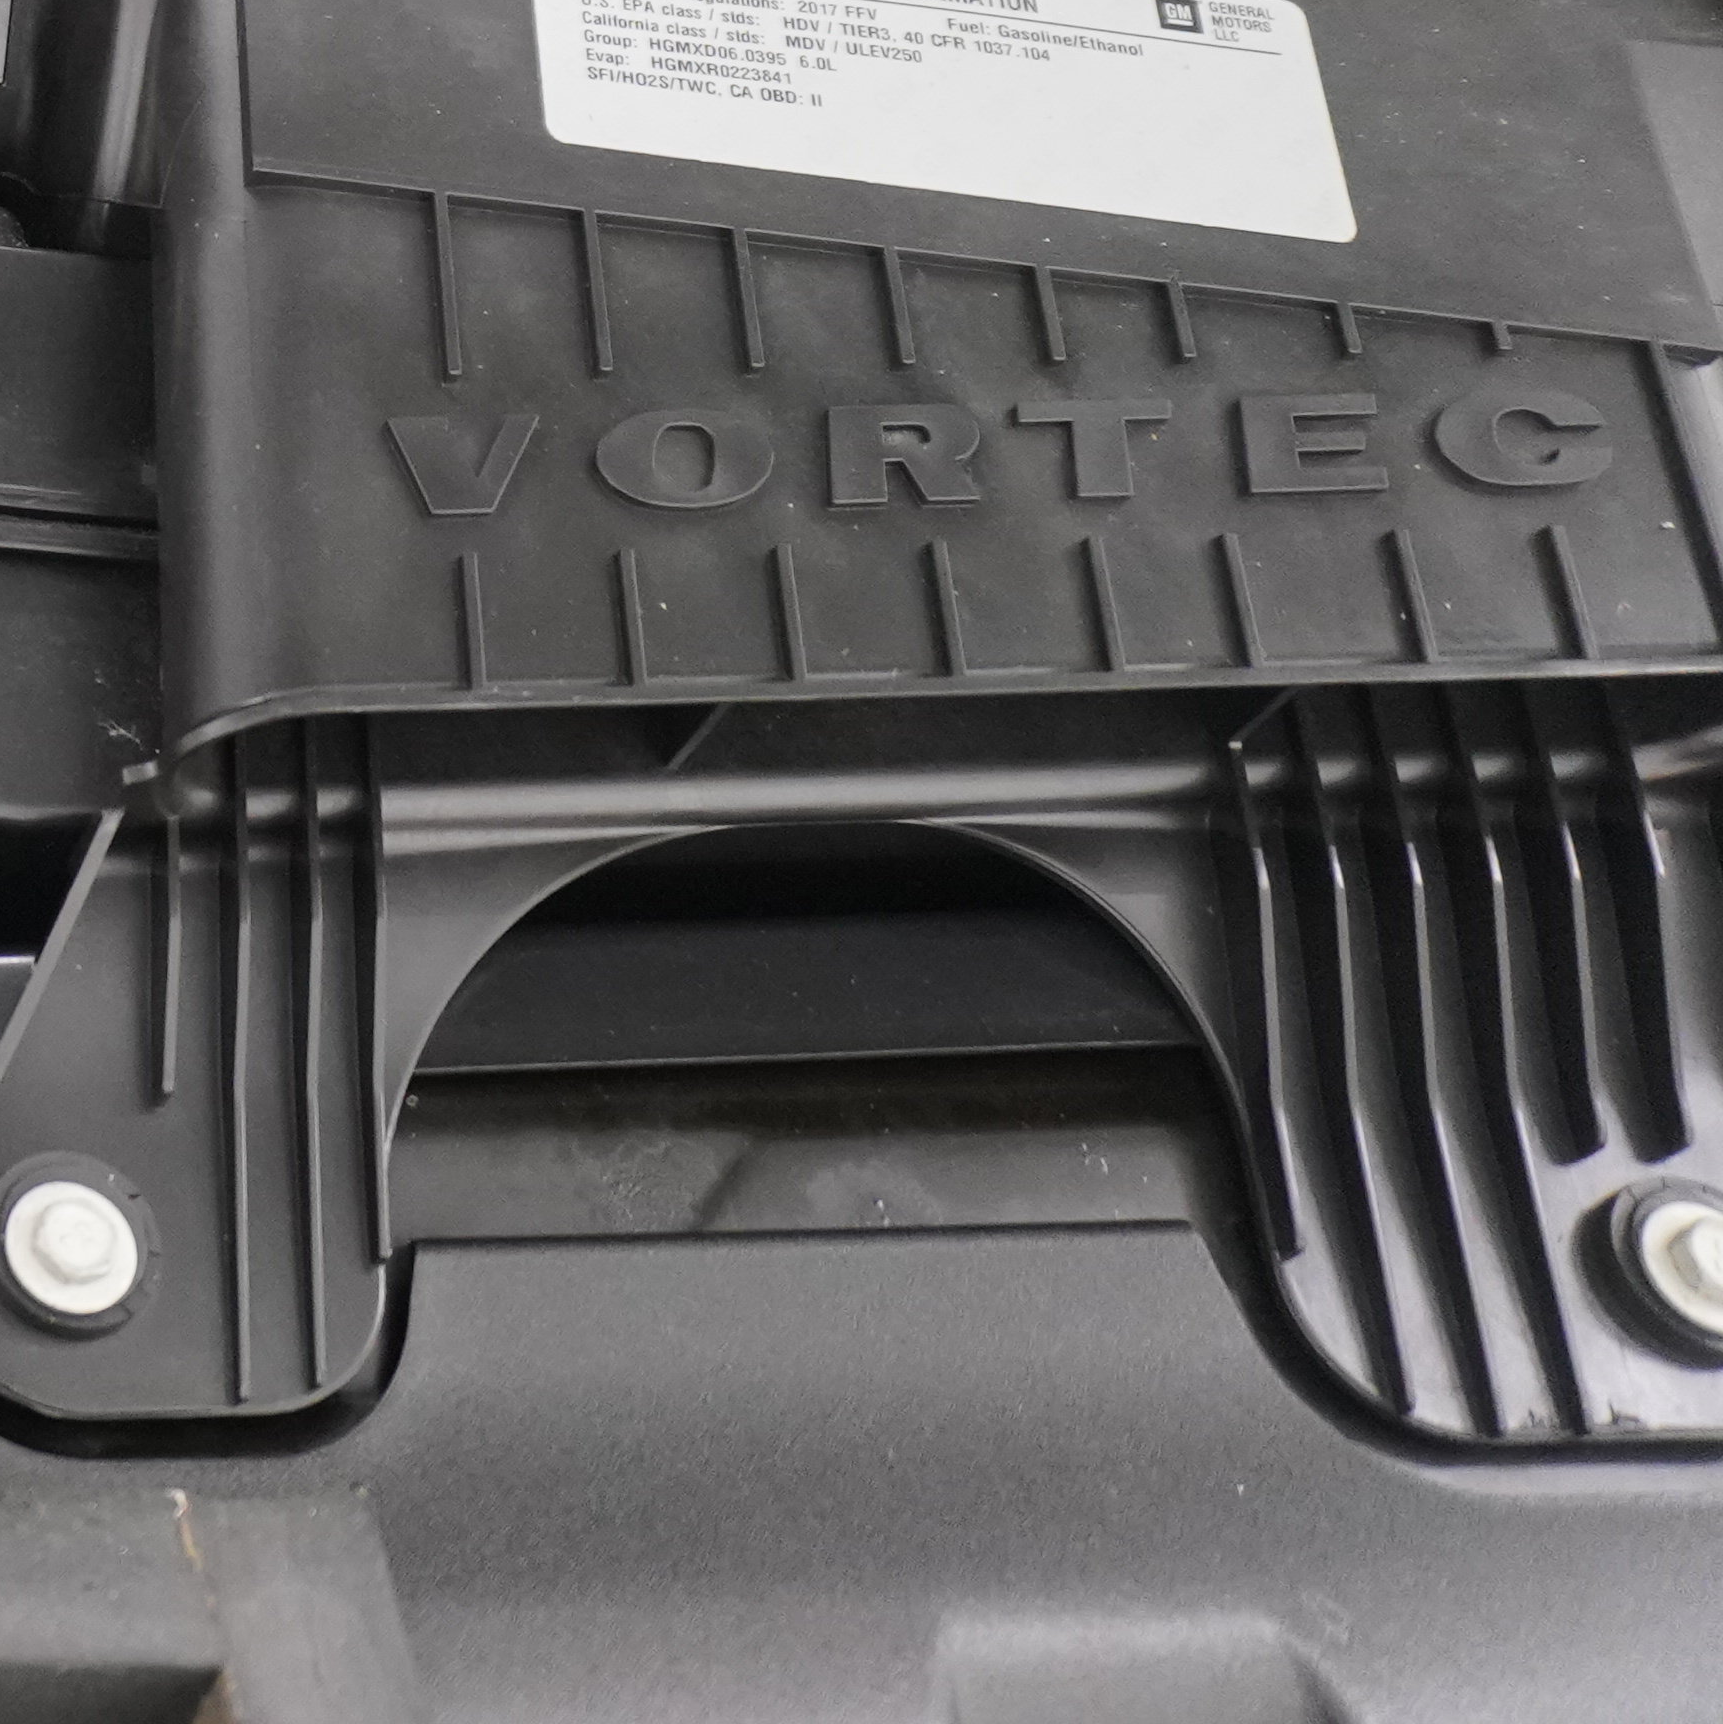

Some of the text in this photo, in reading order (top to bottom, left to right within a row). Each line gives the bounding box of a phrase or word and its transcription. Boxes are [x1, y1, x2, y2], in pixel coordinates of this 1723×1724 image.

[798, 0, 838, 17] 2017
[845, 5, 877, 21] FFV
[1209, 1, 1275, 20] GENERAL
[1211, 15, 1272, 33] MOTORS
[582, 11, 659, 33] California
[666, 22, 706, 39] class
[726, 29, 765, 45] stds:
[785, 35, 825, 52] MDV
[845, 41, 922, 63] ULEV250
[584, 29, 837, 72] Group: HGMXD06.0395 6.0L
[662, 3, 702, 20] class
[721, 11, 760, 26] stds:
[783, 17, 820, 33] HDV
[904, 31, 924, 45] 40
[931, 33, 966, 50] CFR
[974, 40, 1050, 61] 1037.104
[947, 18, 1143, 56] Fuel: Gasoline/Ethanol
[1215, 29, 1239, 42] LLC
[586, 48, 792, 85] Evap: HGMXR0223841
[730, 84, 753, 99] CA
[761, 87, 803, 105] OBD:
[811, 94, 823, 107] II
[386, 390, 1617, 517] VORTEC
